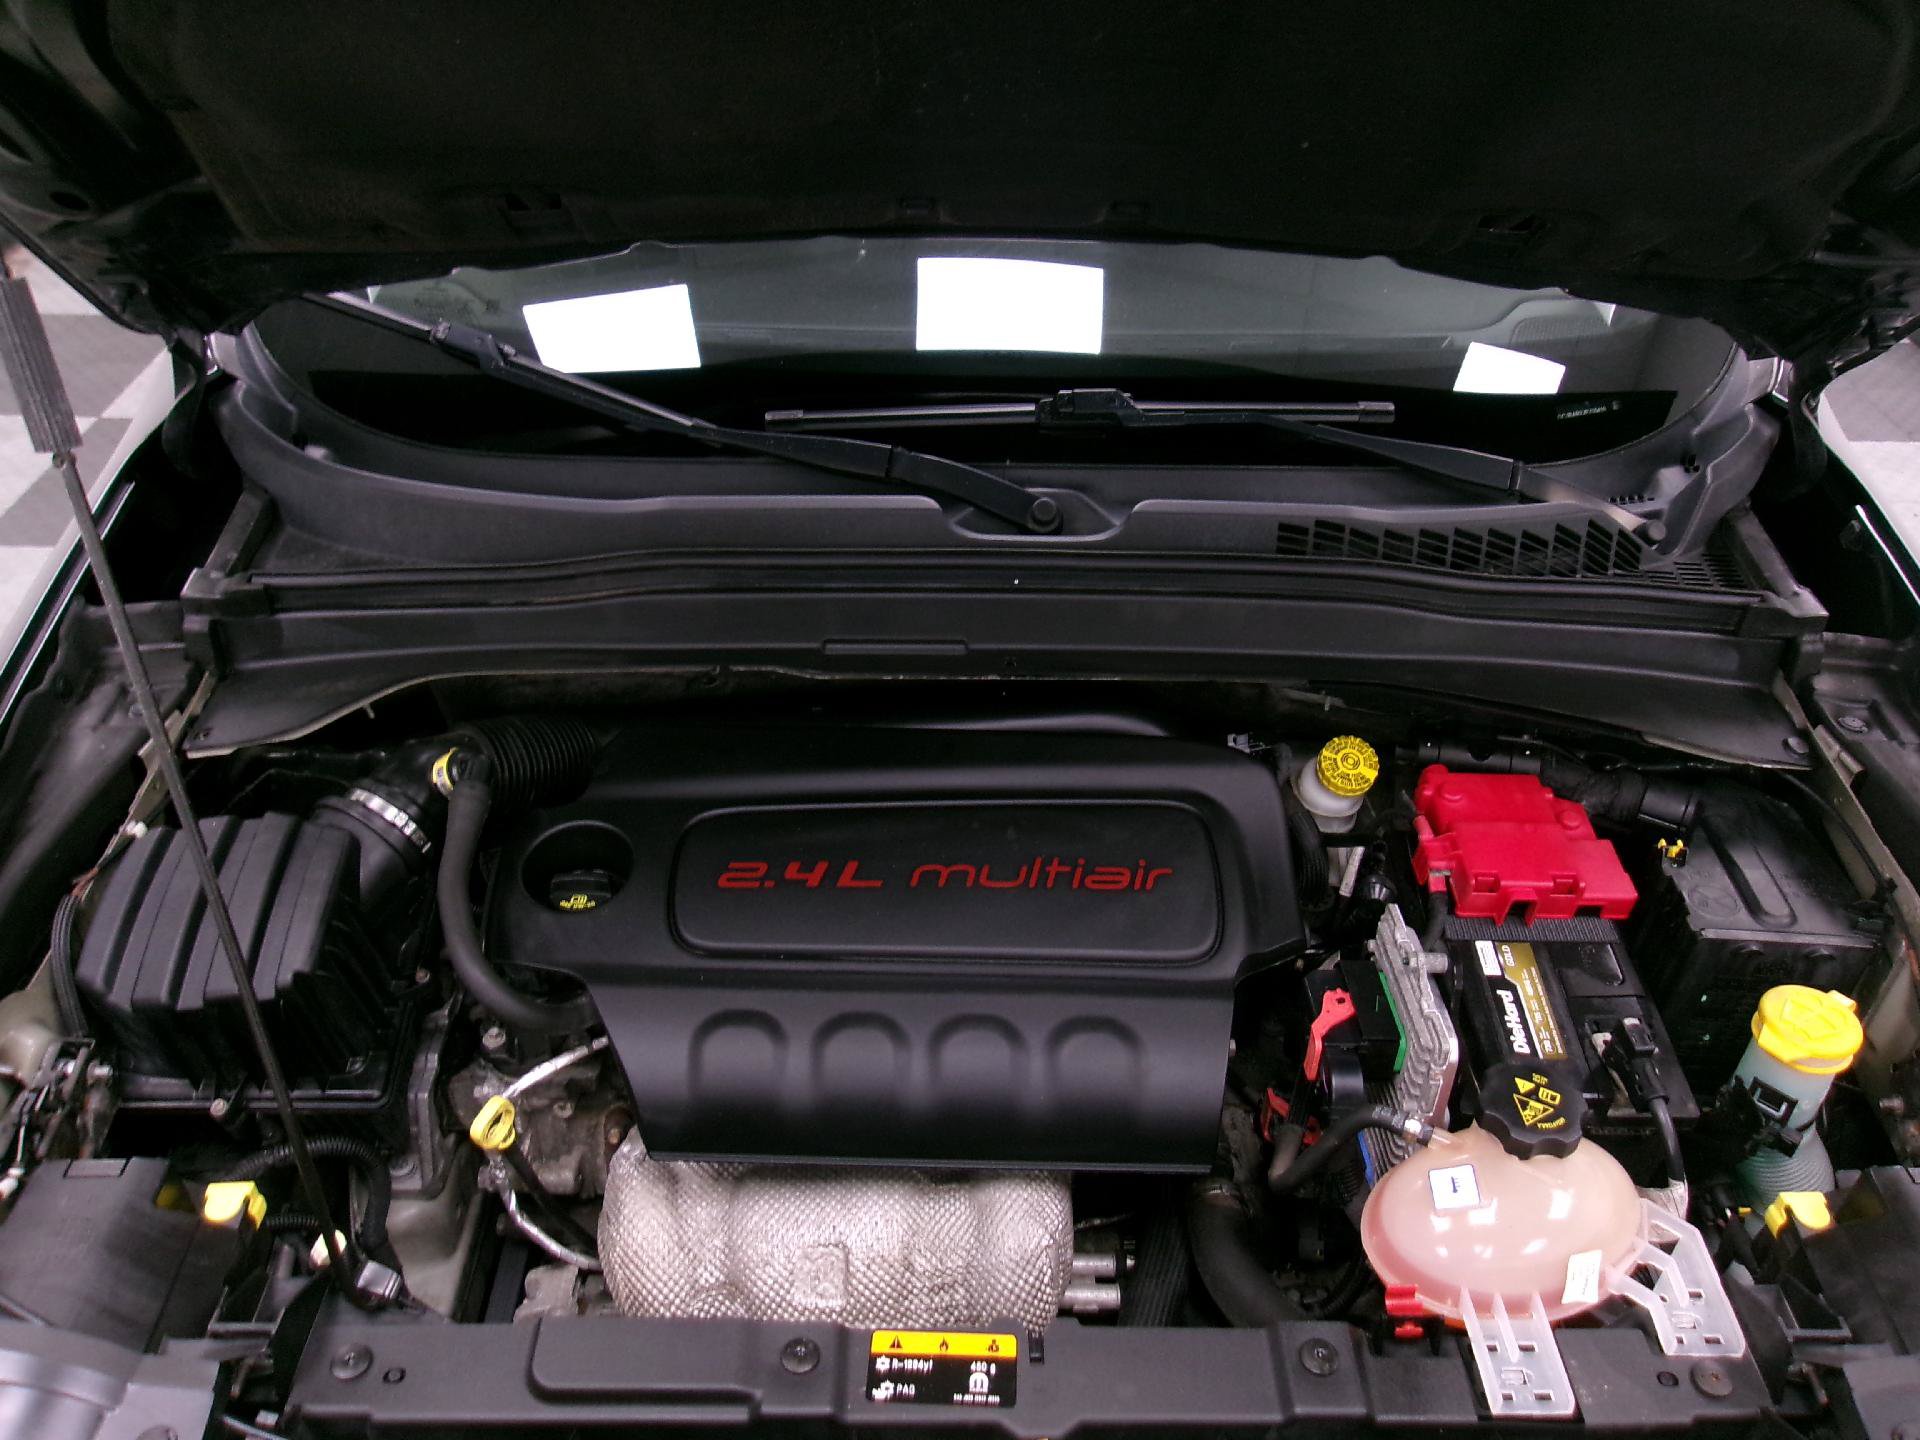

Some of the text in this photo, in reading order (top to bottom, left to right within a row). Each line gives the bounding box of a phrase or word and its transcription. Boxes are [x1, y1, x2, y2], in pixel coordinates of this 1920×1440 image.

[909, 856, 1173, 891] multiair
[1501, 944, 1515, 967] GOLD
[1495, 989, 1531, 1054] DieHard
